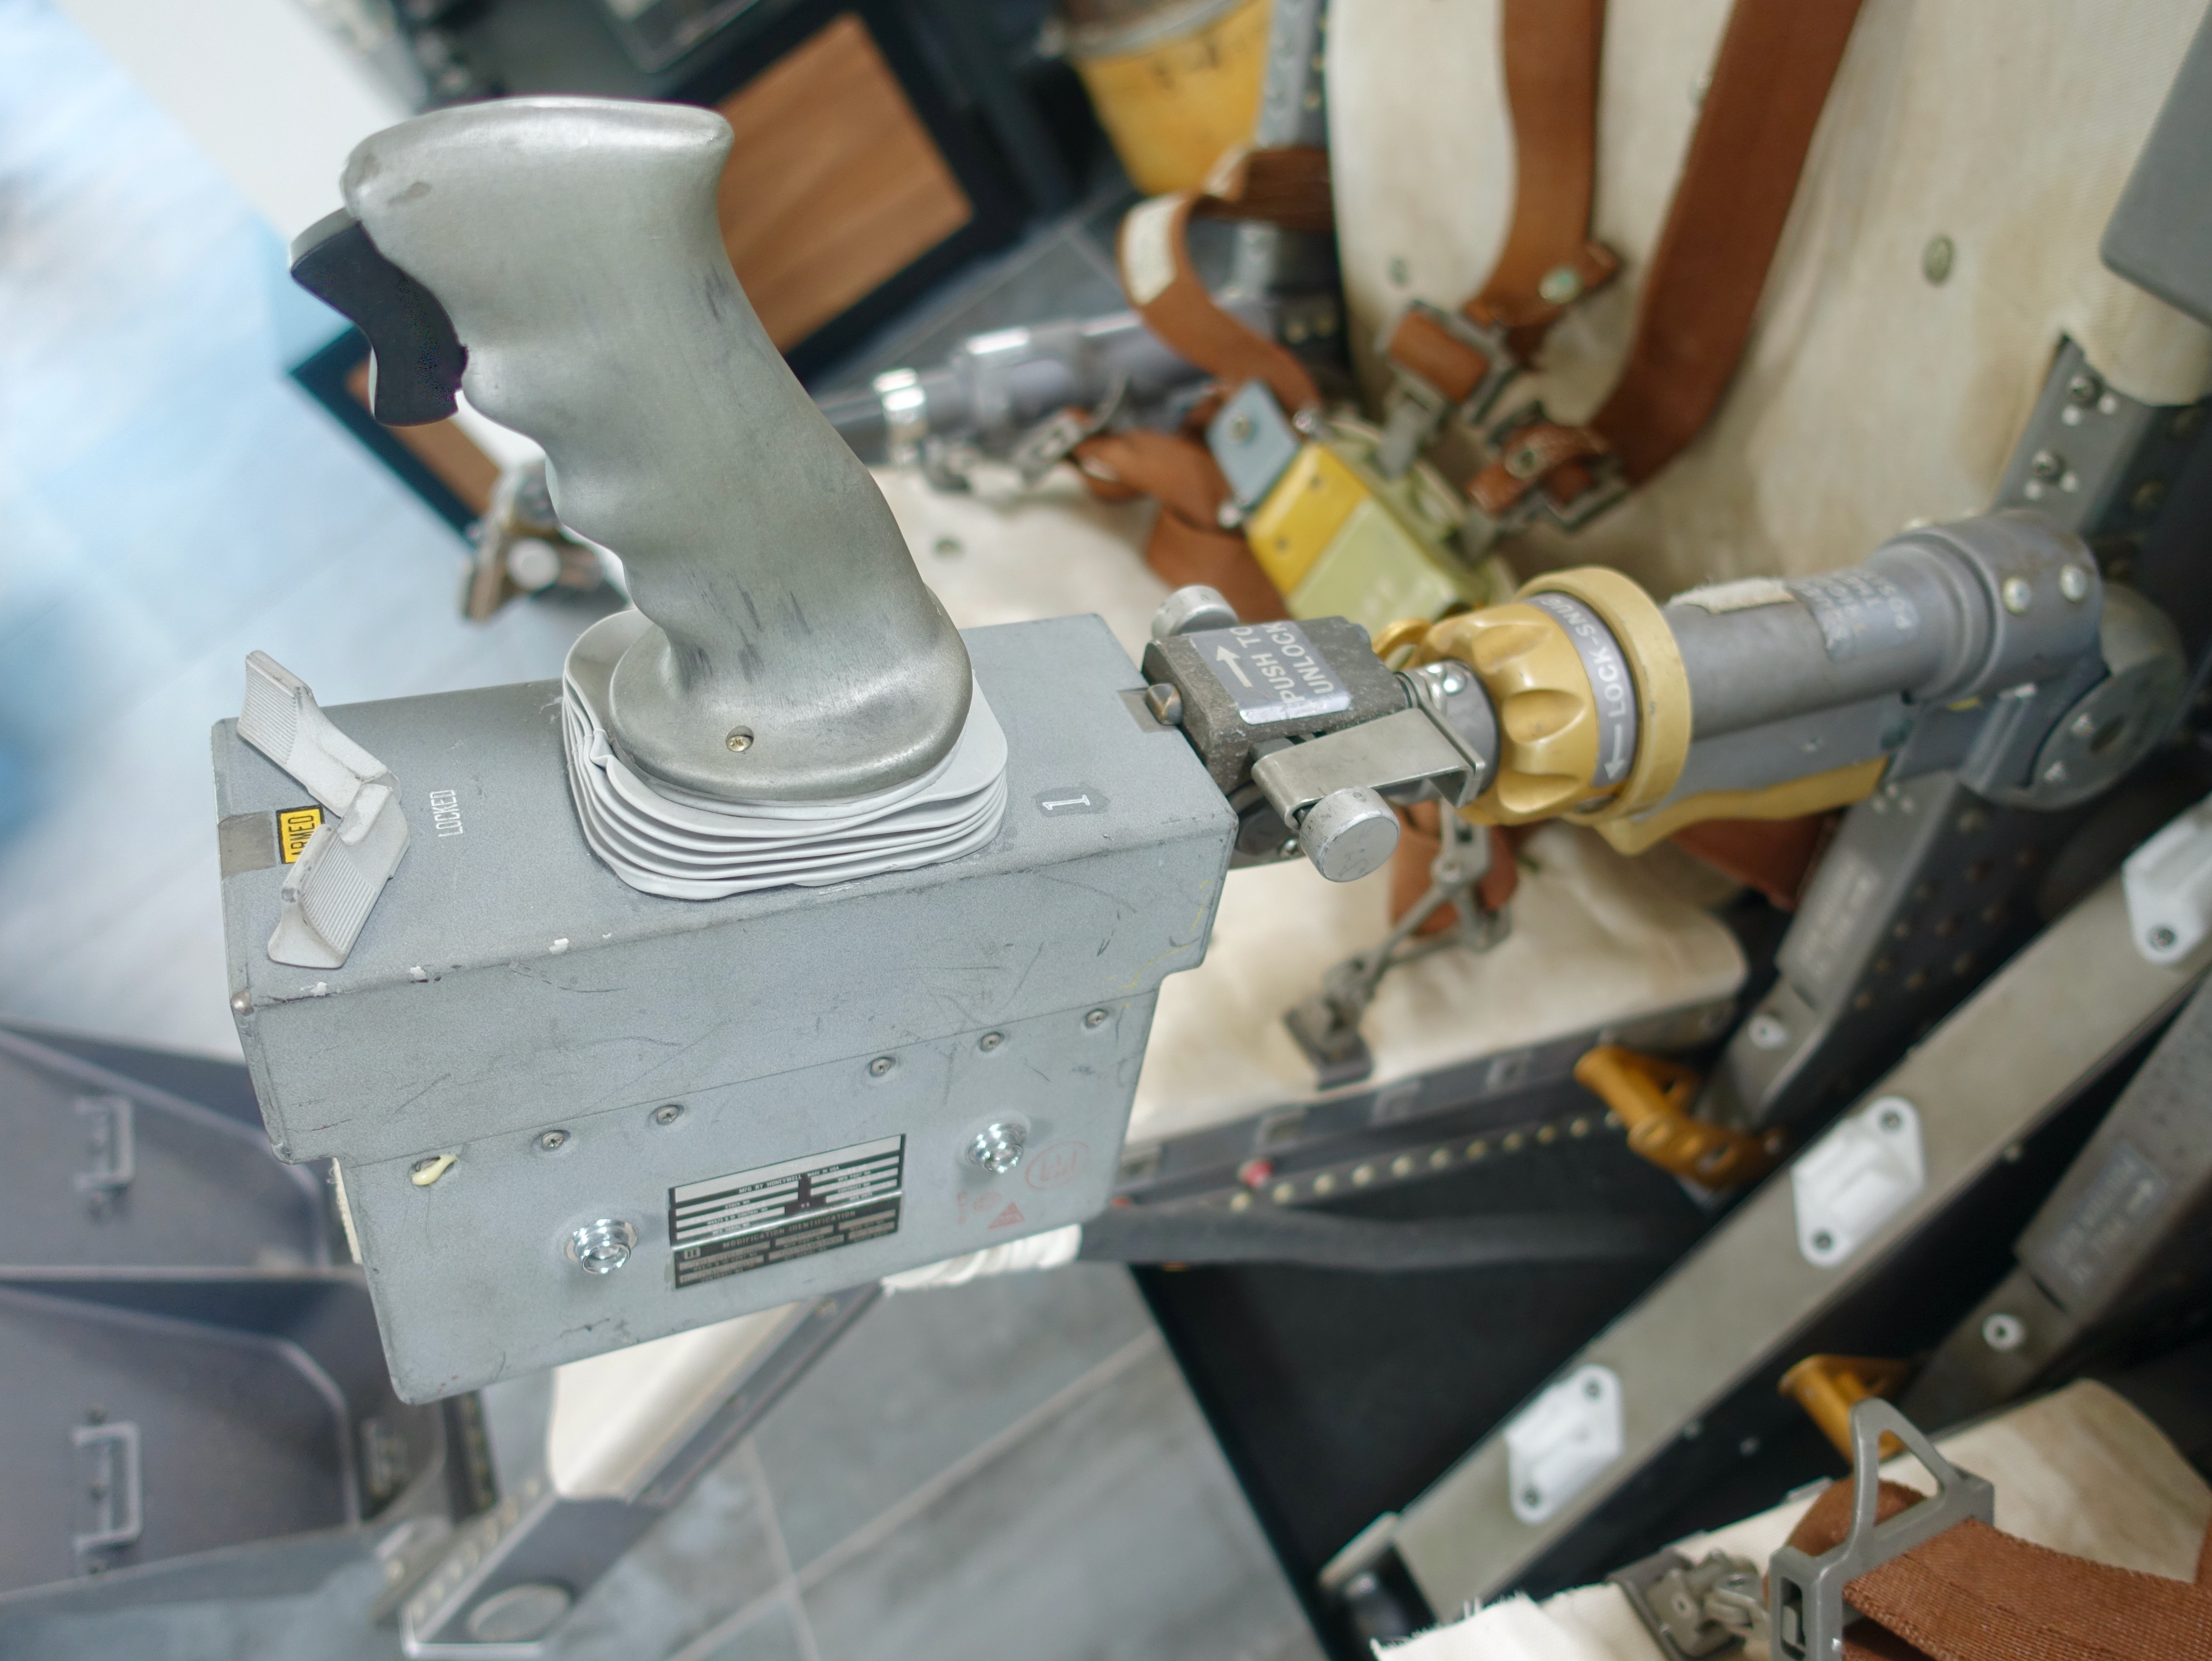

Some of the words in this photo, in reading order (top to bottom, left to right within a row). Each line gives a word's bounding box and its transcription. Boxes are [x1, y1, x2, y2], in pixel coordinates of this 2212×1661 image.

[1230, 627, 1261, 649] TO
[1261, 622, 1334, 694] UNLOCK
[1251, 652, 1306, 703] PUSH
[430, 790, 464, 837] LOCKED
[1042, 794, 1091, 810] 1
[288, 815, 315, 856] RMED
[766, 1173, 802, 1187] HONEYWELL
[723, 1228, 784, 1248] MODIFICATION
